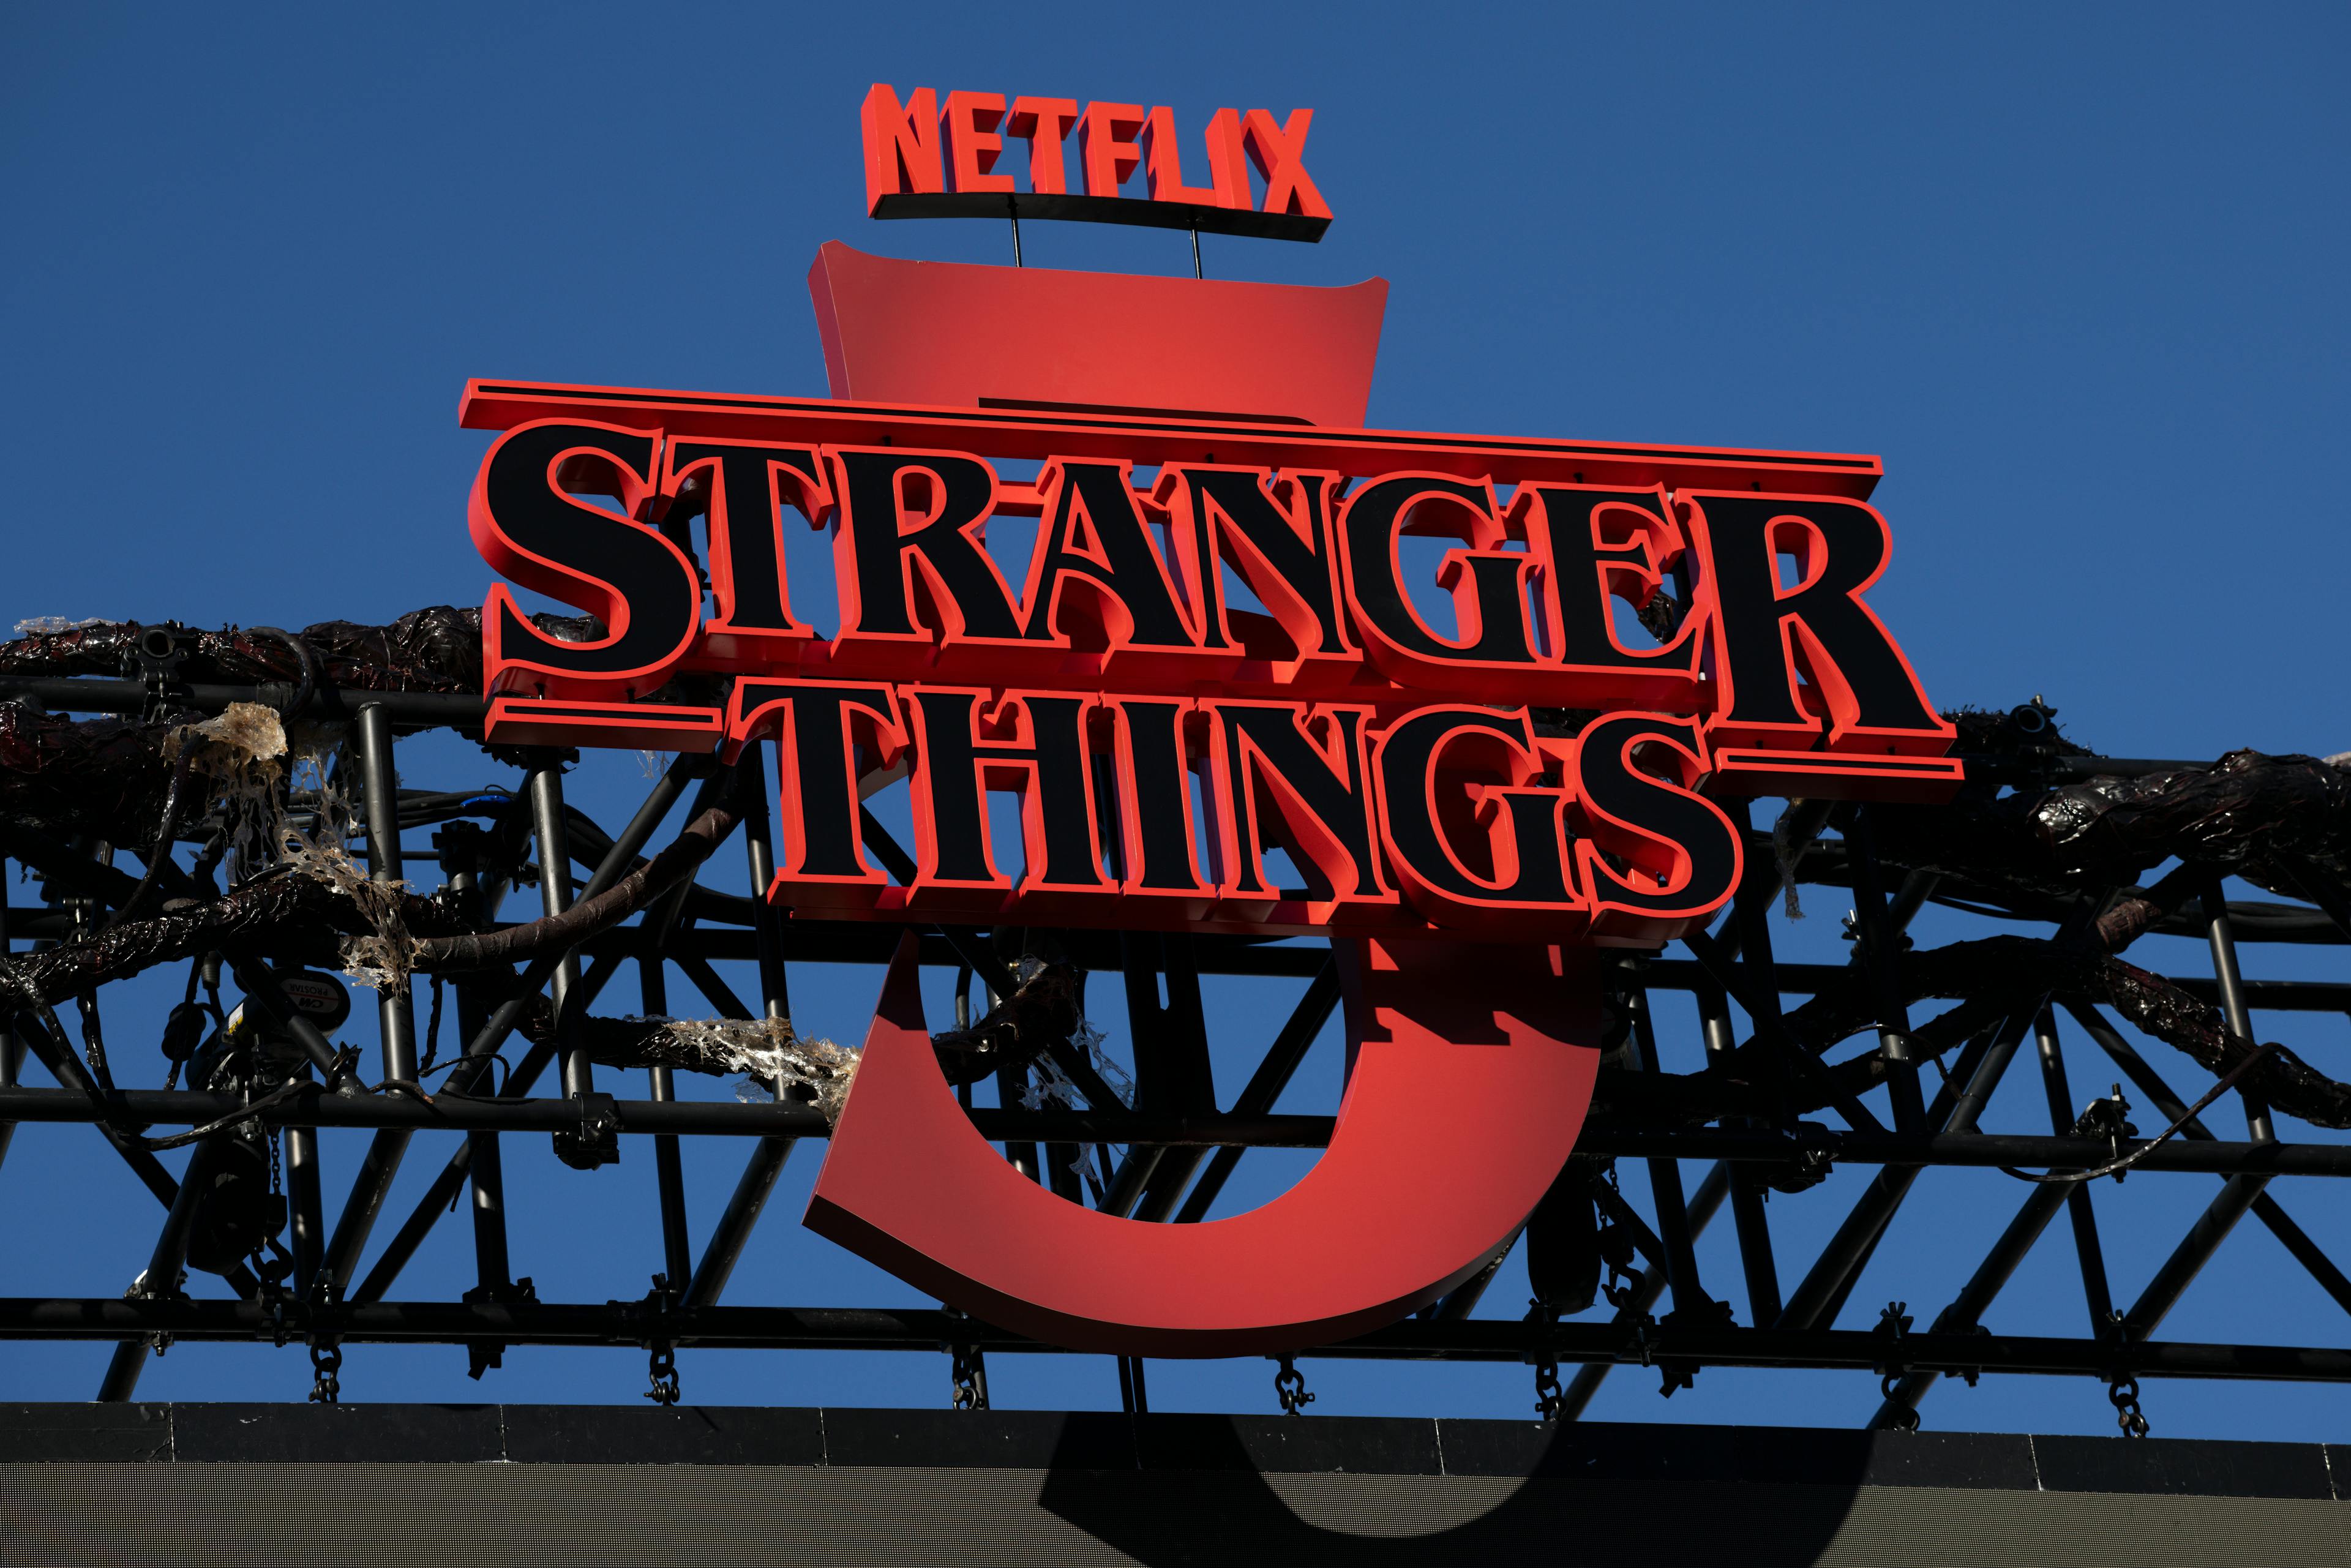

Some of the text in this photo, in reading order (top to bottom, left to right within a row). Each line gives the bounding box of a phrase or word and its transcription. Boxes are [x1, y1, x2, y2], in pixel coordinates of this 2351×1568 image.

[860, 83, 1334, 220] NETFLIX
[470, 417, 1957, 742] STRANGER
[727, 675, 1744, 923] THINGS
[290, 983, 328, 996] PROSTAR
[298, 997, 324, 1008] CM
